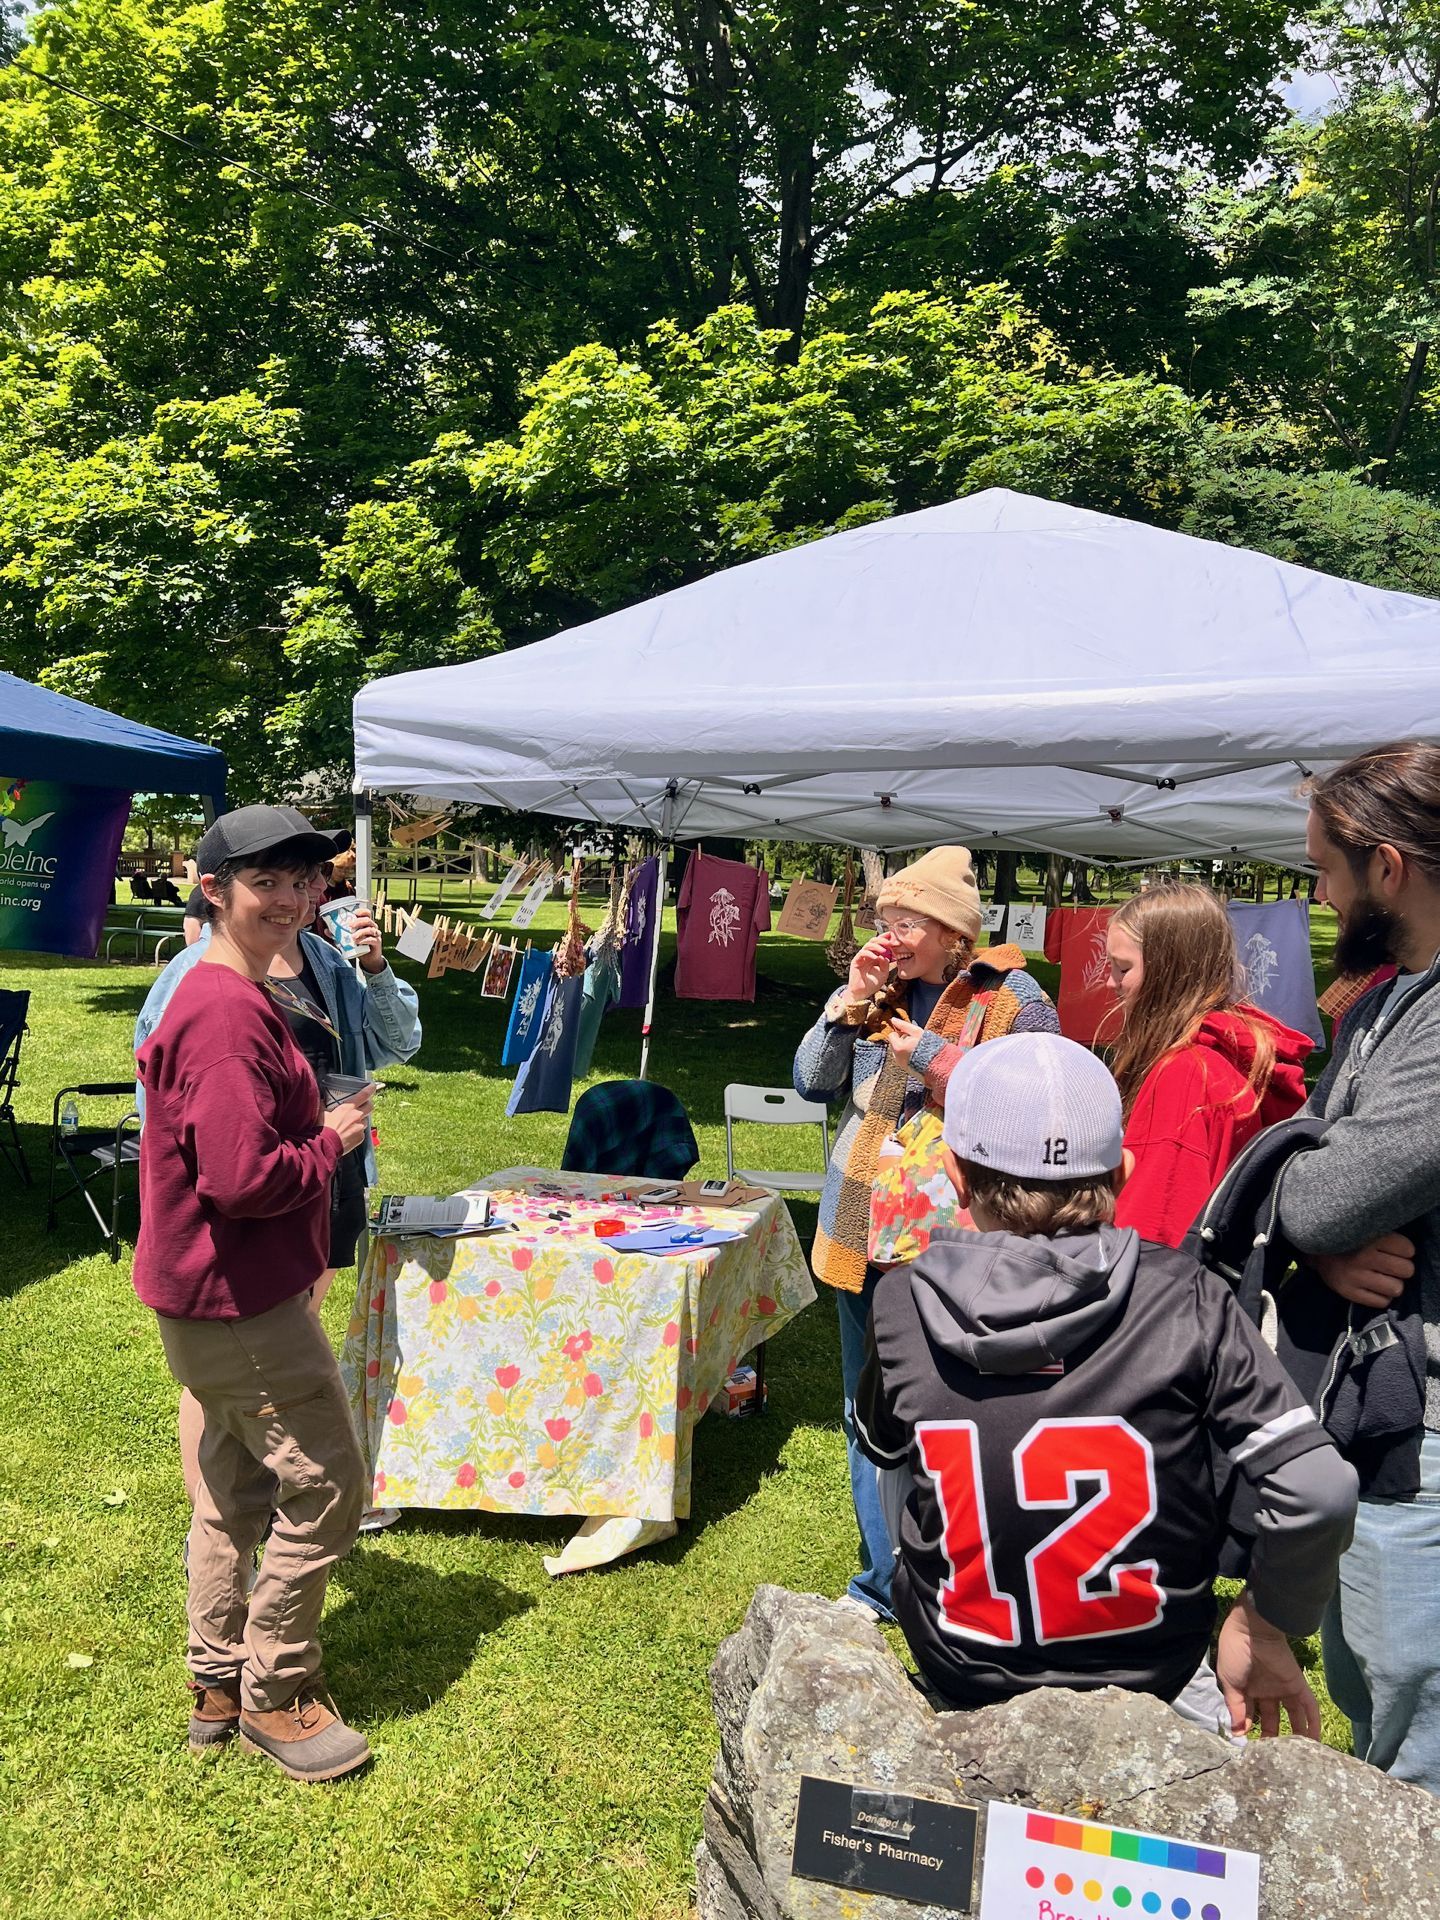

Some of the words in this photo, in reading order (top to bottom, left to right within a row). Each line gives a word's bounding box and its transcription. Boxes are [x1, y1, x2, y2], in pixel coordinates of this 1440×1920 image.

[16, 880, 38, 888] opens
[40, 882, 50, 890] up
[0, 893, 41, 911] inc.org
[1043, 1137, 1068, 1165] 12
[915, 1416, 1167, 1646] 12
[857, 1811, 899, 1830] Donated
[902, 1821, 915, 1834] by
[822, 1830, 872, 1853] Fisher's
[878, 1842, 943, 1871] Pharmacy
